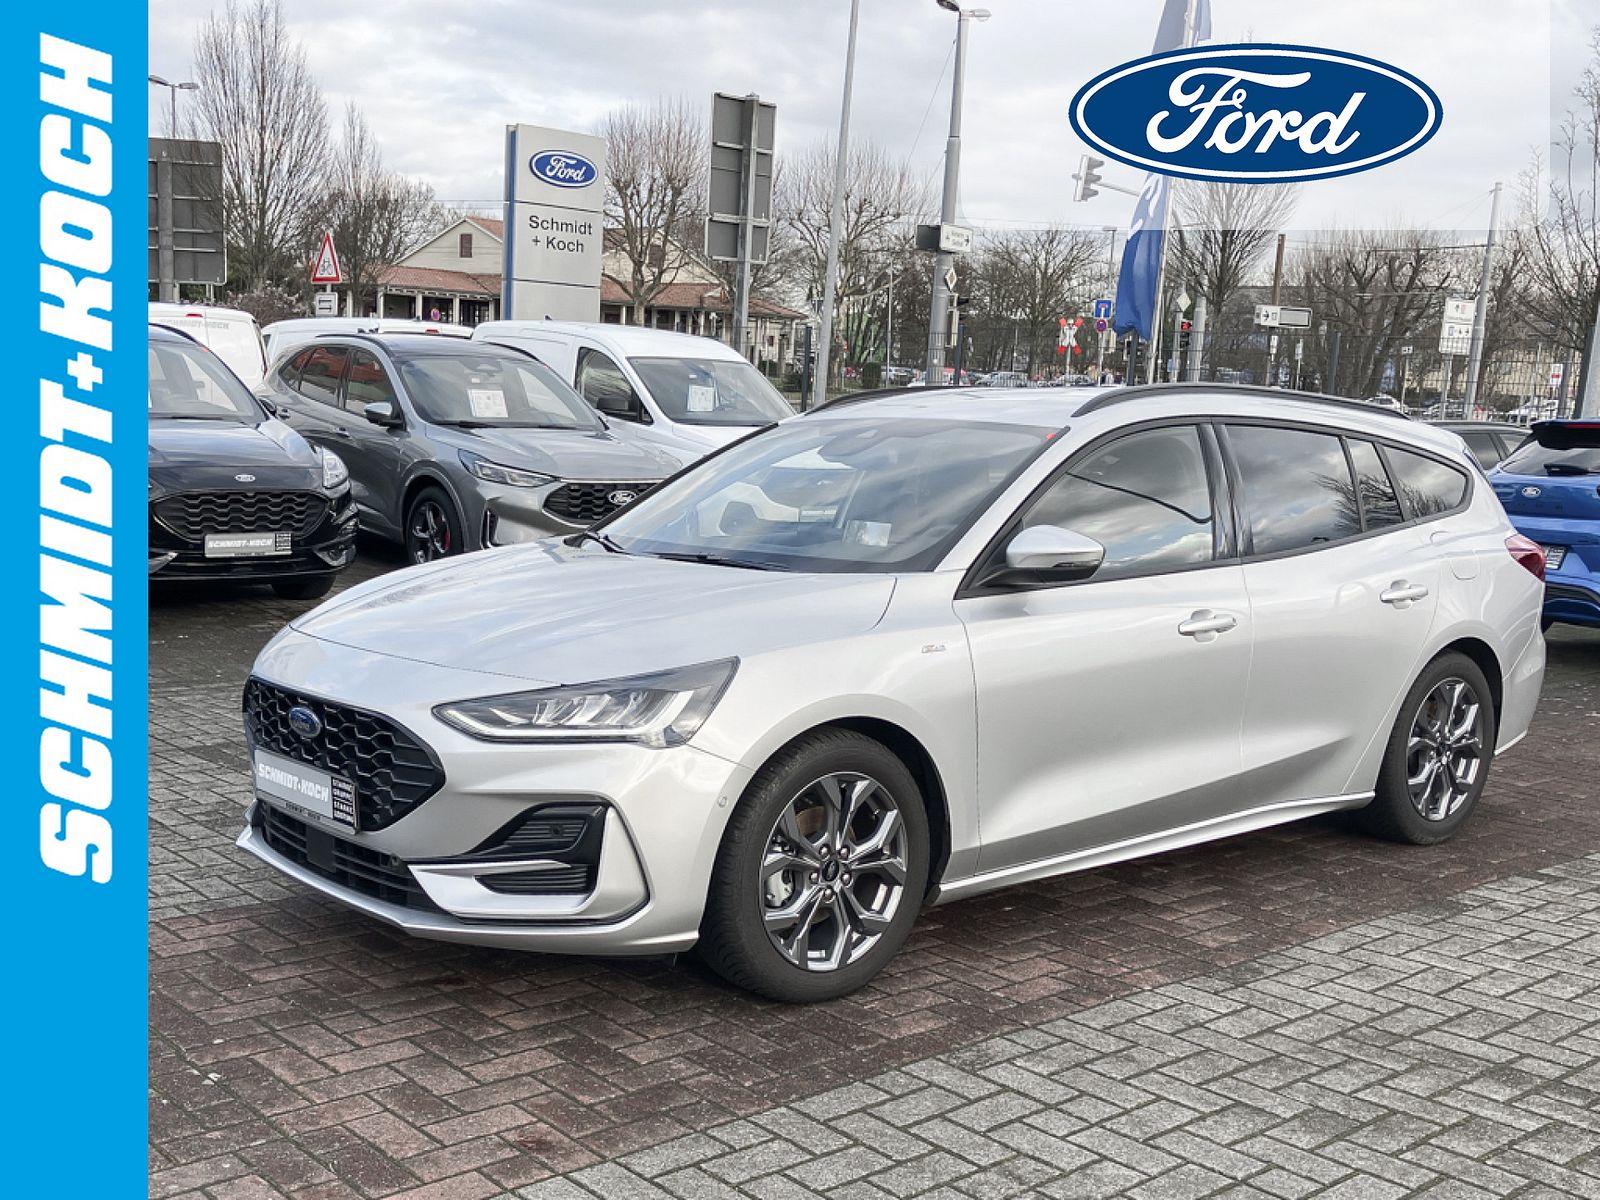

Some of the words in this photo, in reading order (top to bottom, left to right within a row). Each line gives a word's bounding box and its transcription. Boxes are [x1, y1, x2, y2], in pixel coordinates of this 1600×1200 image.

[546, 155, 586, 181] Ford
[529, 215, 592, 235] Schmidt
[531, 235, 541, 246] +
[546, 236, 584, 253] Koch
